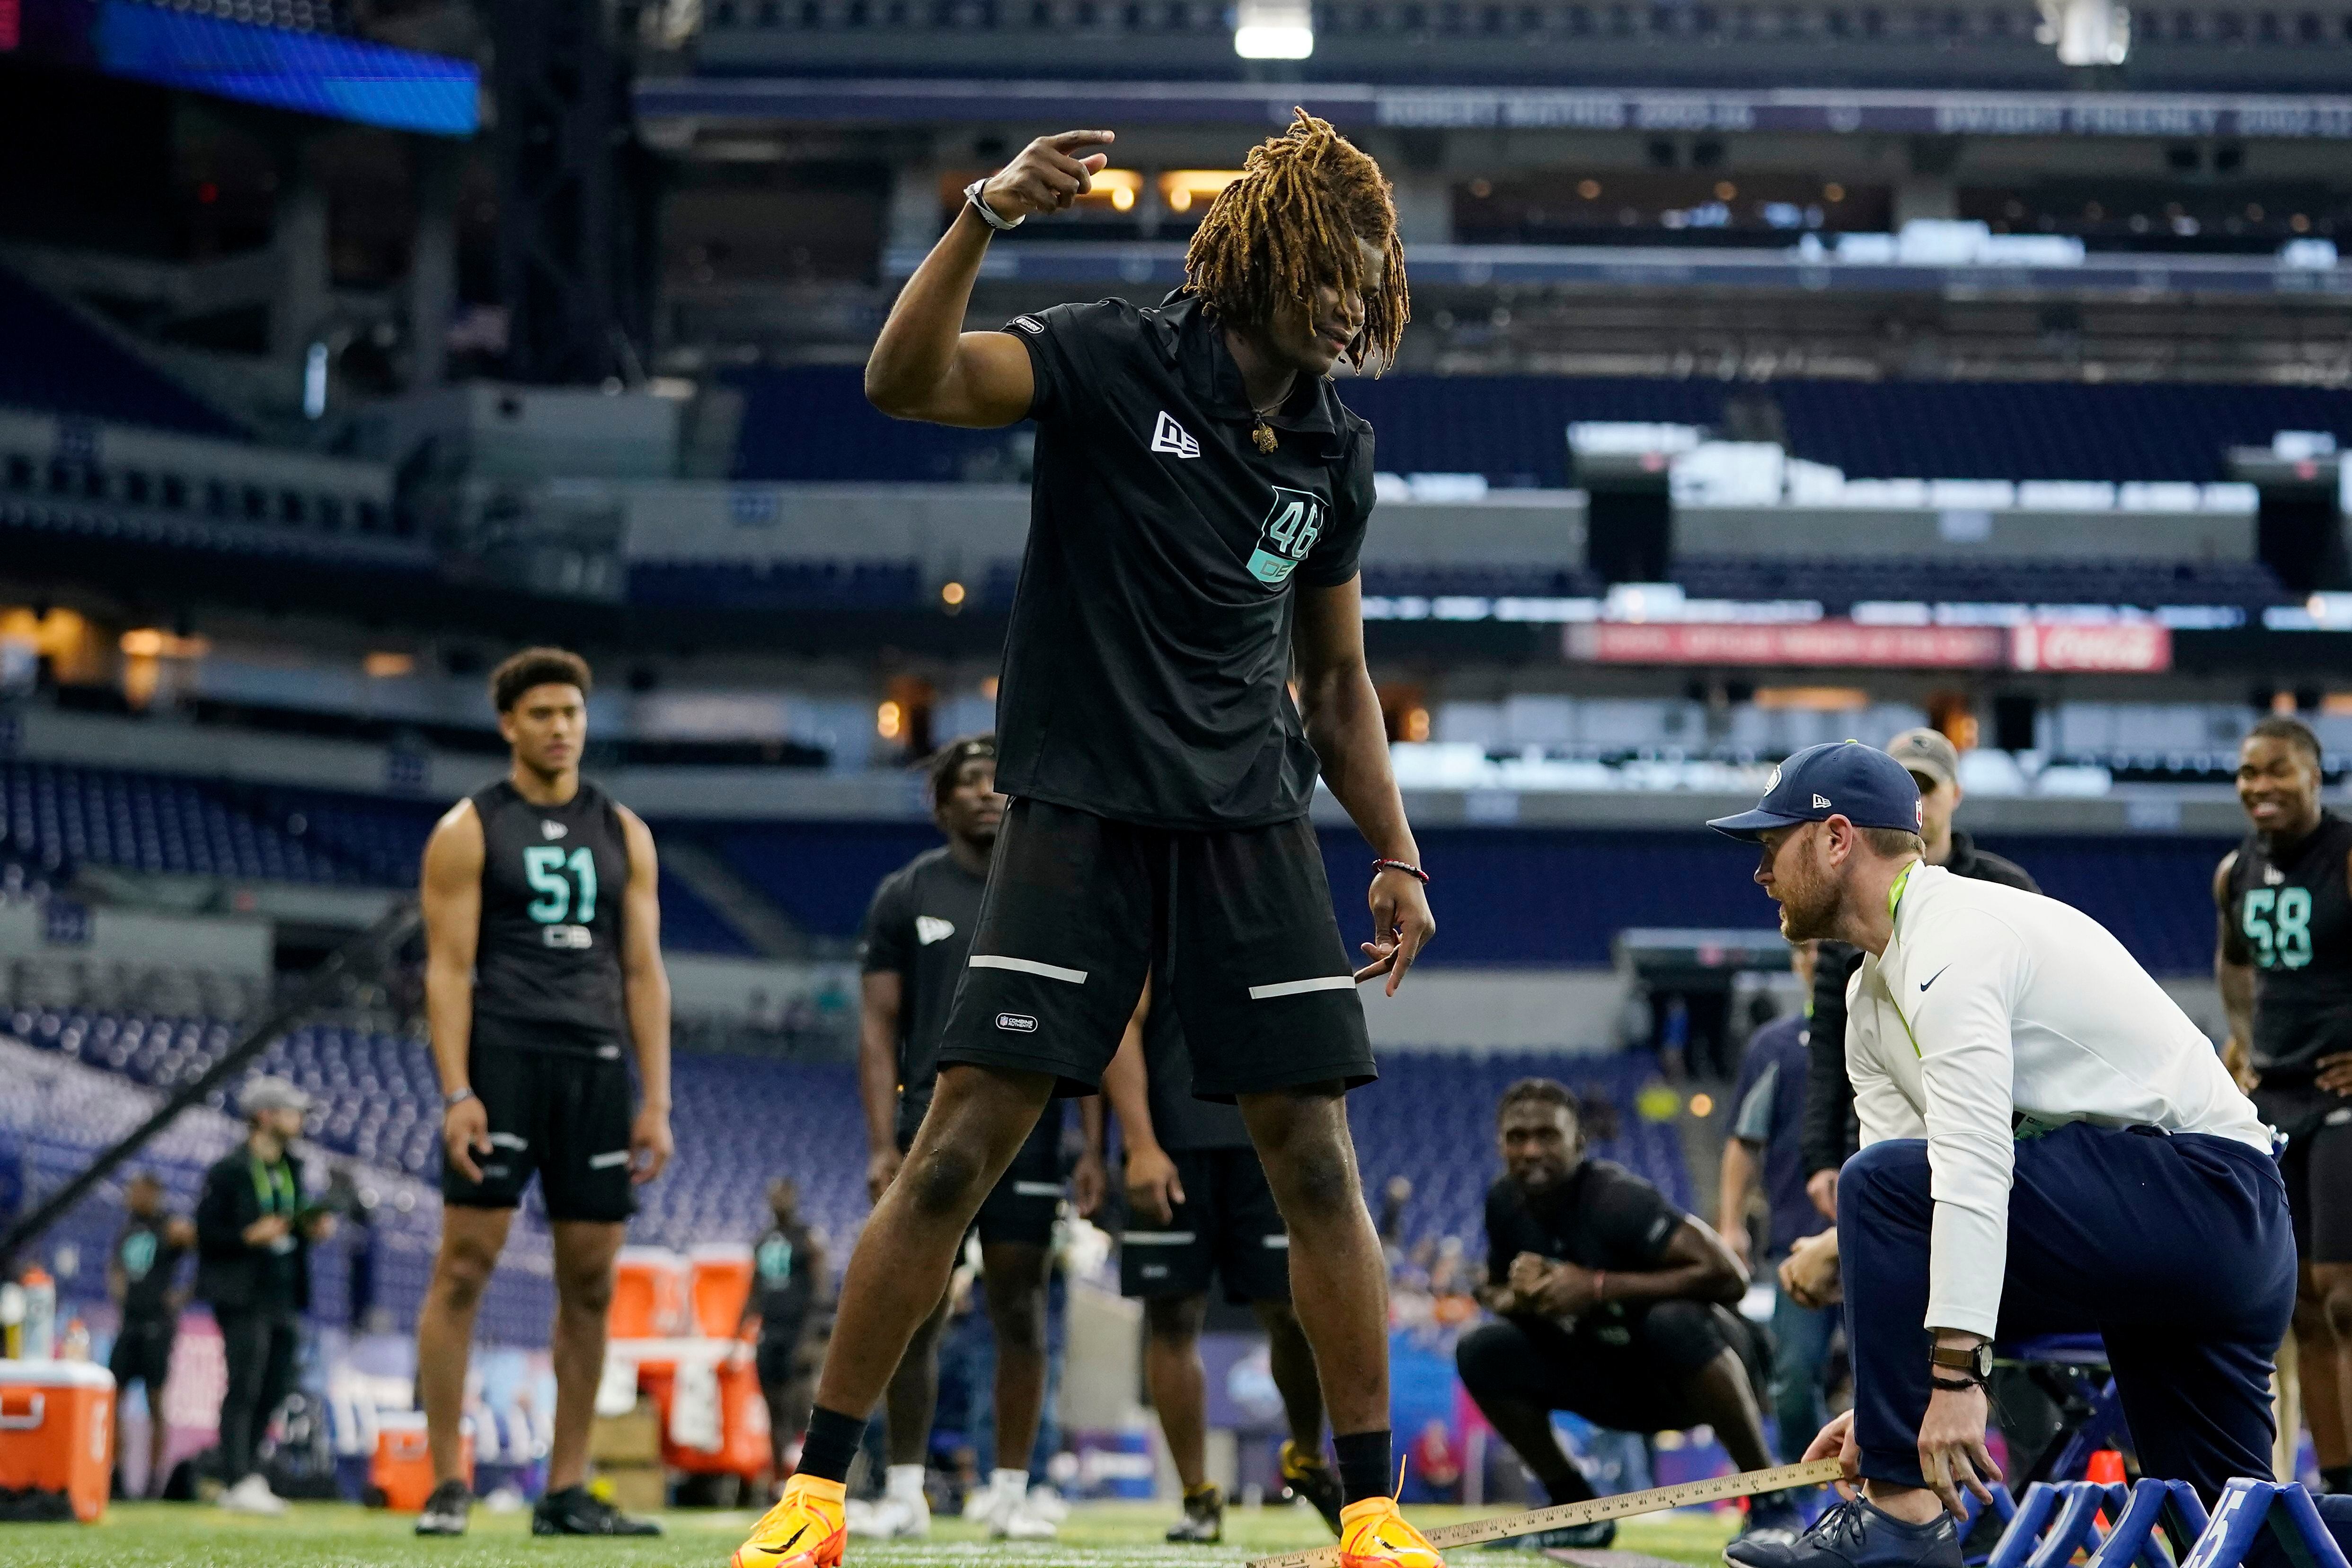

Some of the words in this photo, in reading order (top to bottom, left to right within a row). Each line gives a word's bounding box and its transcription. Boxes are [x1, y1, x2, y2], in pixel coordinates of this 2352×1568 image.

[1270, 502, 1318, 558] 46
[524, 846, 598, 923] 51
[2243, 887, 2313, 969] 58
[1009, 1018, 1034, 1026] COMBINE
